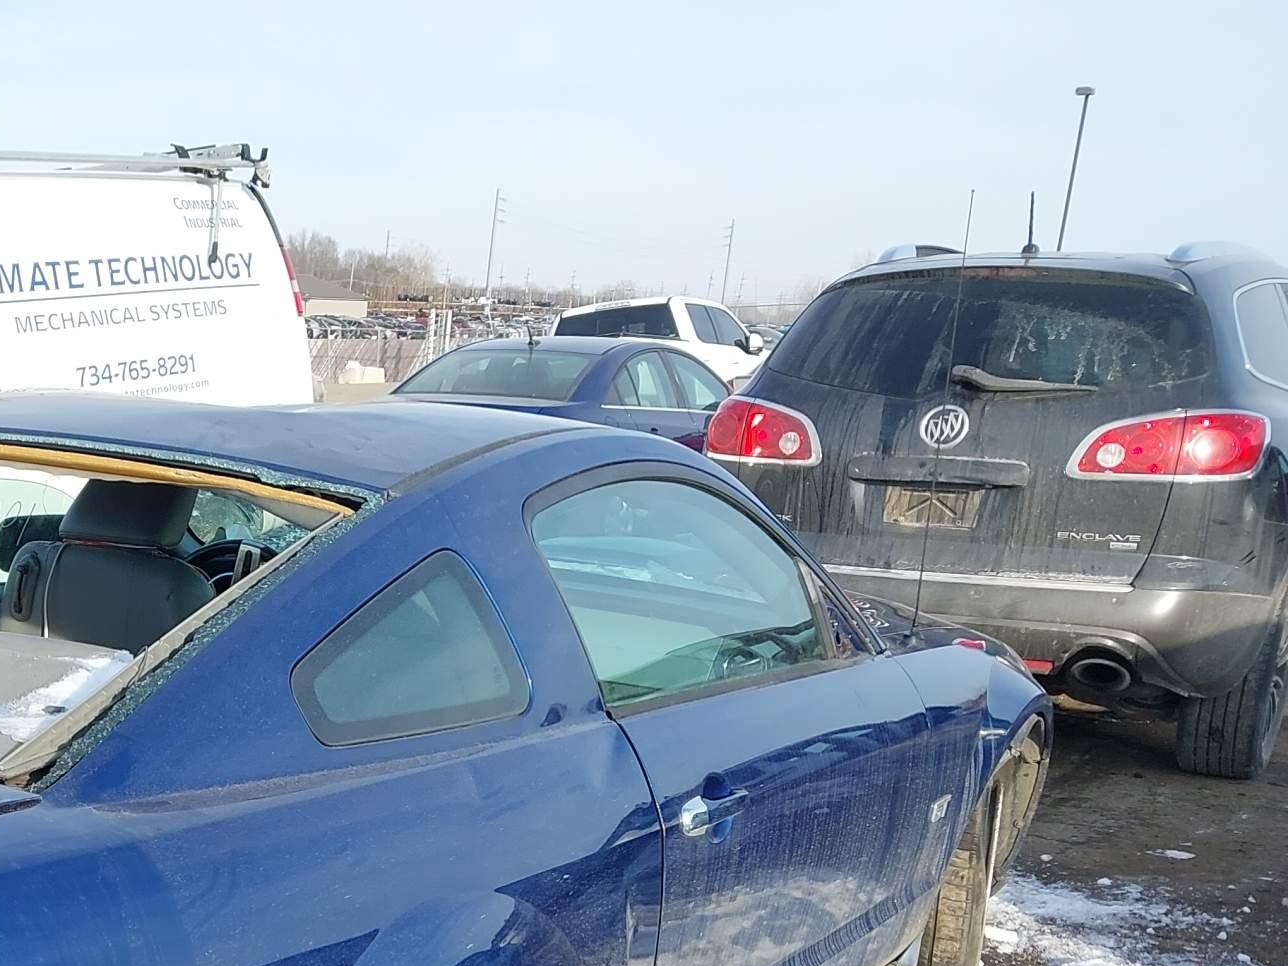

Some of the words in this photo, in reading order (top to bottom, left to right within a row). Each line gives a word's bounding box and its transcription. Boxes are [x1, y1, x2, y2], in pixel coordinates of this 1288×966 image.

[88, 252, 253, 288] TECHNOLOGY
[14, 306, 146, 334] MECHANICAL
[149, 299, 228, 322] SYSTEMS
[75, 353, 197, 388] 734-765-8291
[1056, 531, 1142, 542] ENCLAVE
